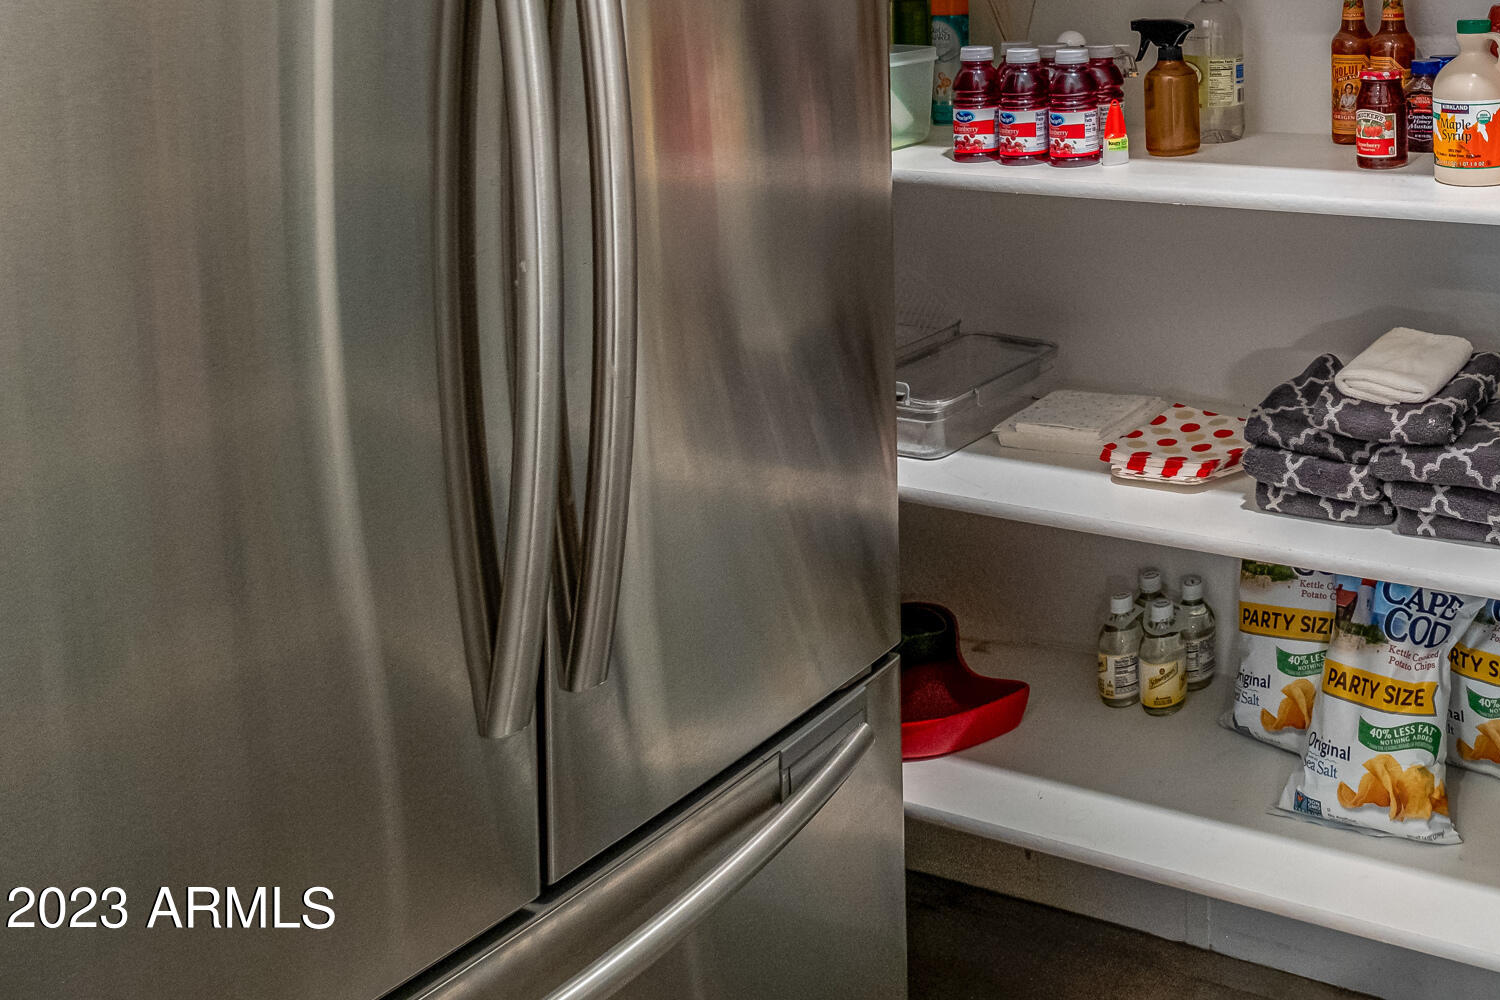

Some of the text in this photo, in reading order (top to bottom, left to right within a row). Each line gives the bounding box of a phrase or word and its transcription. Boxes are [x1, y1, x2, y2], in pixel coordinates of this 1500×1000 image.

[1440, 118, 1471, 133] Maple
[1442, 130, 1472, 144] Syrup
[1299, 579, 1325, 590] Kettle
[1301, 590, 1327, 600] Potato
[1382, 581, 1465, 621] CAPE
[1242, 608, 1296, 631] PARTY
[1384, 606, 1452, 648] COD
[1288, 655, 1308, 665] 40%
[1388, 644, 1439, 662] Kettle Cooked
[1450, 646, 1482, 672] RTY
[1388, 656, 1436, 672] Potato Chips
[1328, 667, 1426, 707] PARTY SIZE
[1241, 692, 1260, 707] Salt
[1478, 697, 1500, 709] 40%
[1369, 724, 1435, 740] 40% LESS FAT
[1308, 731, 1351, 762] Original
[1380, 736, 1433, 746] NOTHING ADDED
[1317, 761, 1338, 779] Salt
